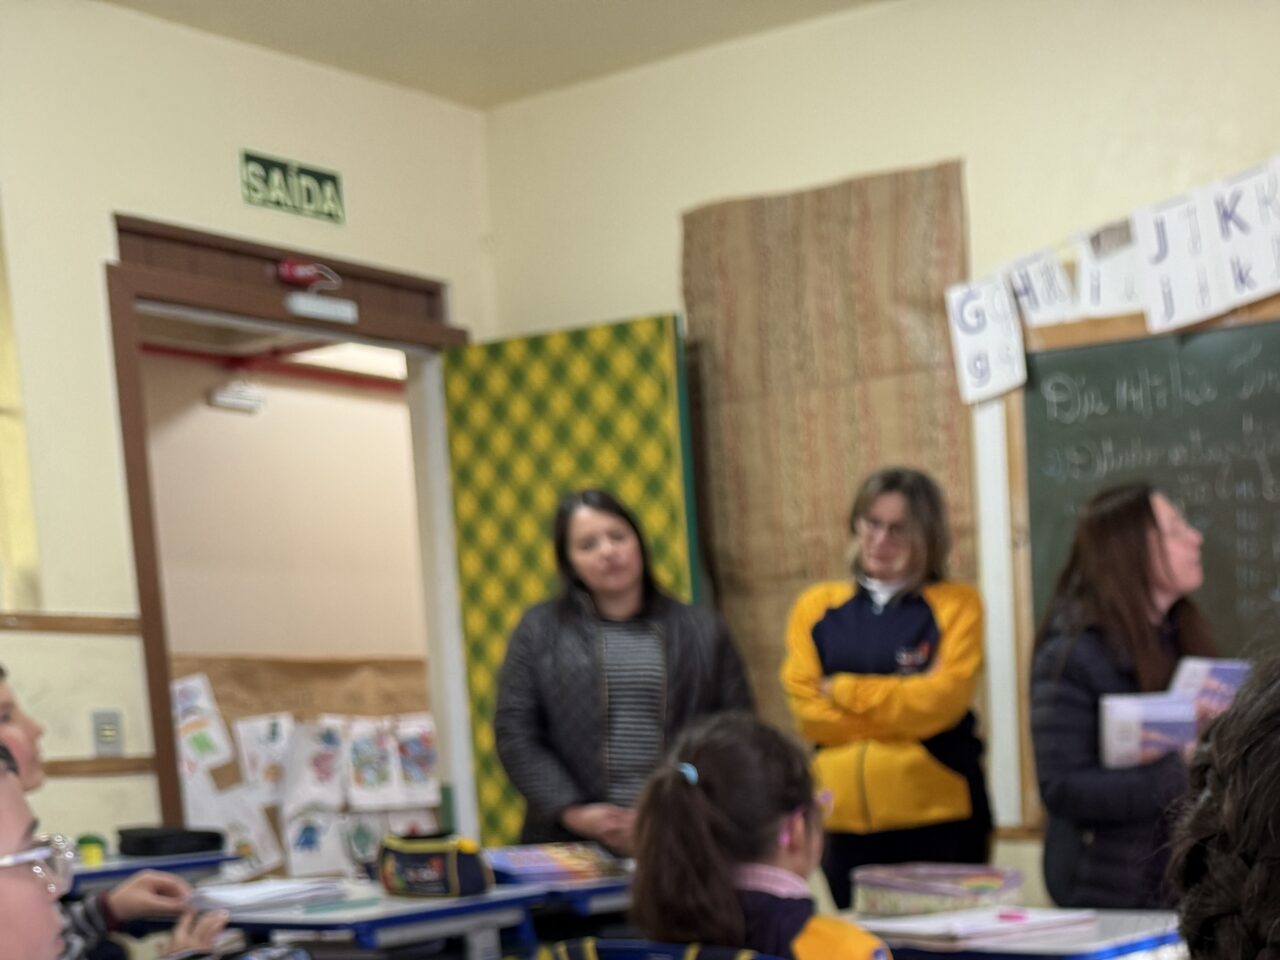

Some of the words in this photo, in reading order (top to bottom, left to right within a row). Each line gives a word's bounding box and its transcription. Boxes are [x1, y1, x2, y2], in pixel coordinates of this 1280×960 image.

[246, 160, 343, 218] SAÍDA
[1215, 189, 1252, 241] K
[1149, 215, 1169, 264] J
[1013, 267, 1041, 311] H
[1230, 256, 1258, 294] k
[953, 288, 988, 335] G
[967, 350, 992, 388] g
